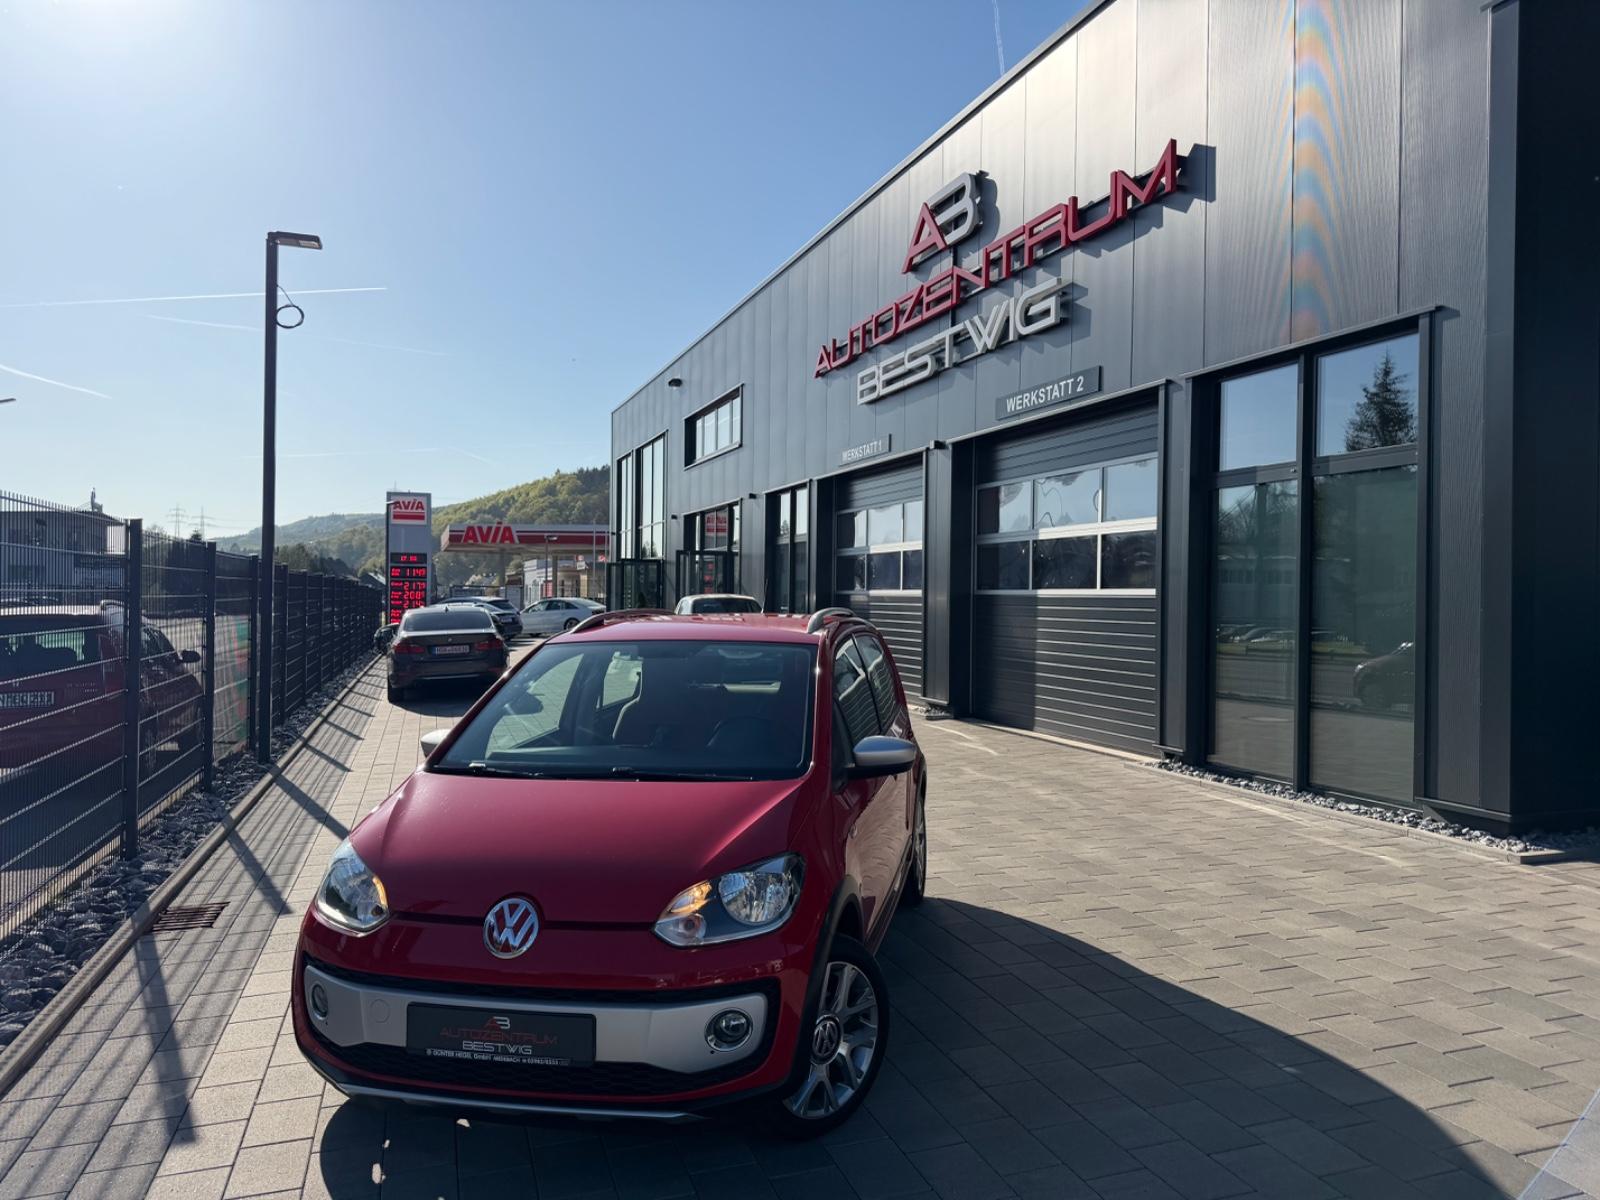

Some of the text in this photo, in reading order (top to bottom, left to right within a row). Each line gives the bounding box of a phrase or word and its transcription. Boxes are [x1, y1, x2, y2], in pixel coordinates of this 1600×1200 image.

[814, 139, 1180, 379] AUTOZENTRUM
[856, 277, 1064, 405] BESTWIG
[1005, 375, 1085, 413] WERKSTATT 2
[841, 441, 878, 462] WERKSTATT
[393, 498, 425, 511] AVIA
[462, 521, 515, 544] AVIA
[440, 1027, 559, 1045] AUTOZENTRUM
[462, 1040, 532, 1055] BESTWIG
